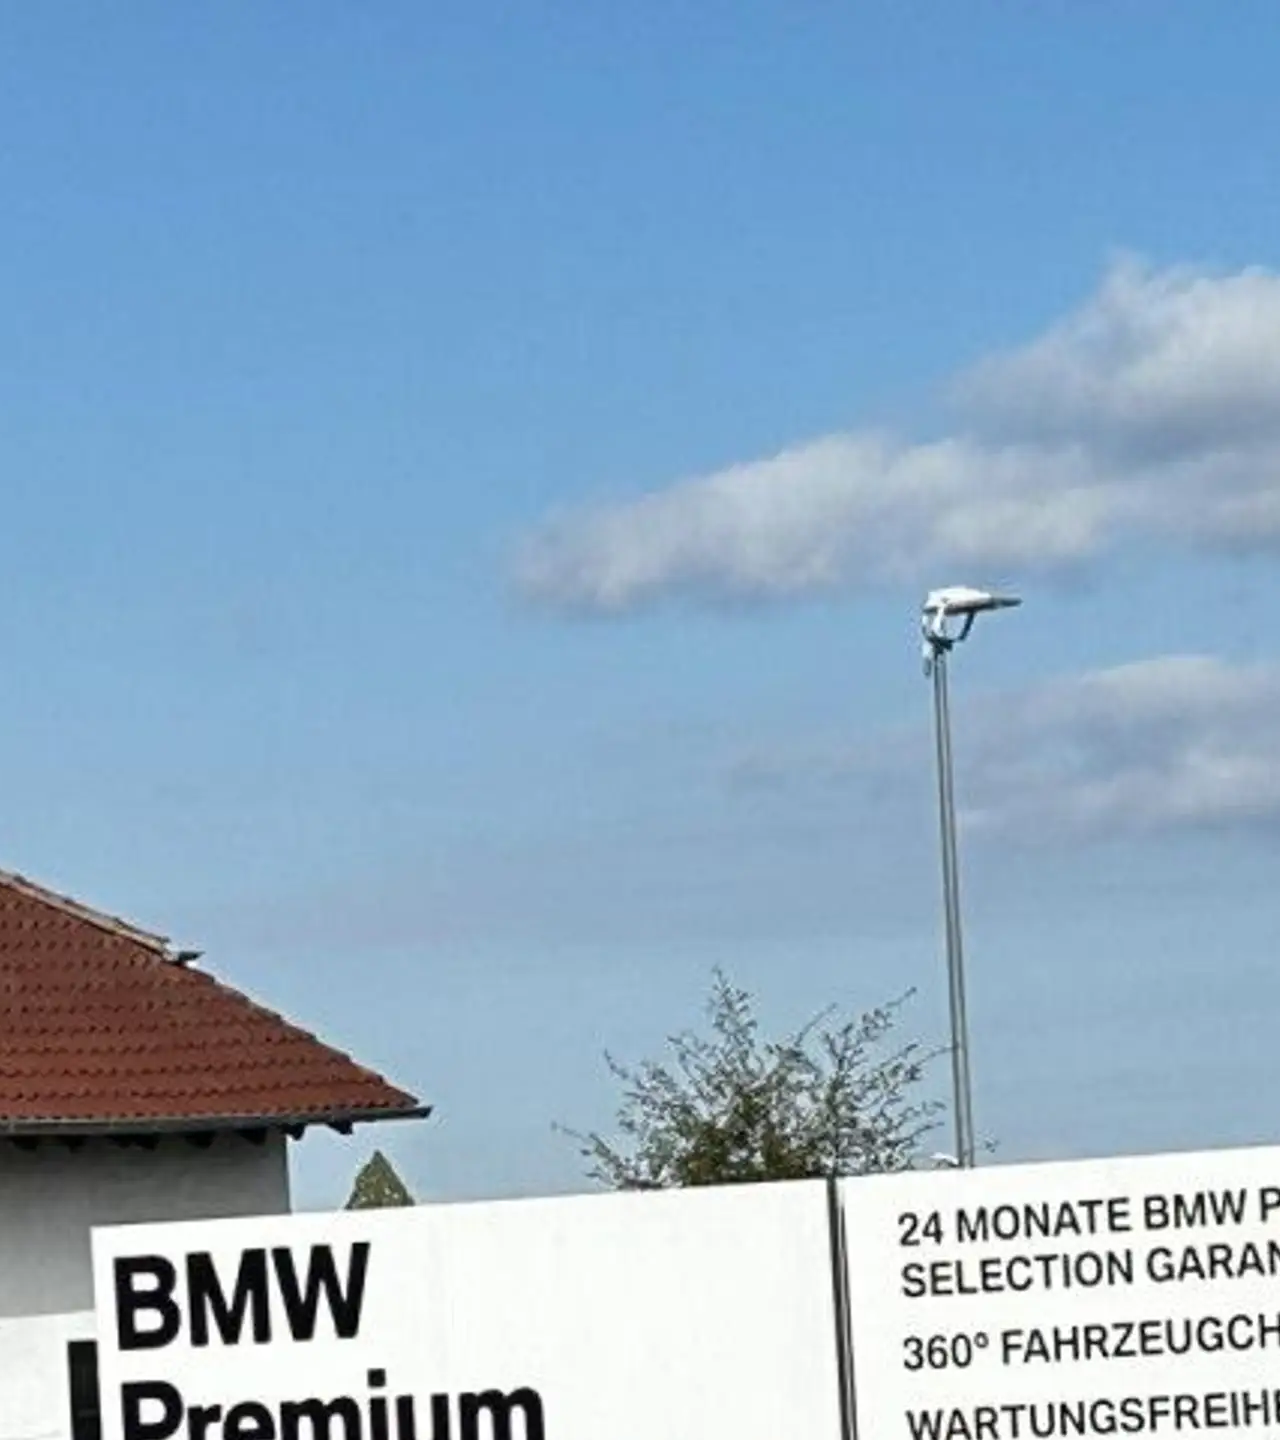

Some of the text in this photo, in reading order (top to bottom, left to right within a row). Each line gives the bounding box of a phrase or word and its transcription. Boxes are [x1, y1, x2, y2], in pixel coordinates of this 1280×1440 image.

[898, 1211, 943, 1247] 24
[956, 1196, 1132, 1243] MONATE
[1143, 1188, 1247, 1230] BMW
[113, 1240, 371, 1351] BMW
[901, 1248, 1133, 1298] SELECTION
[903, 1331, 989, 1371] 360°
